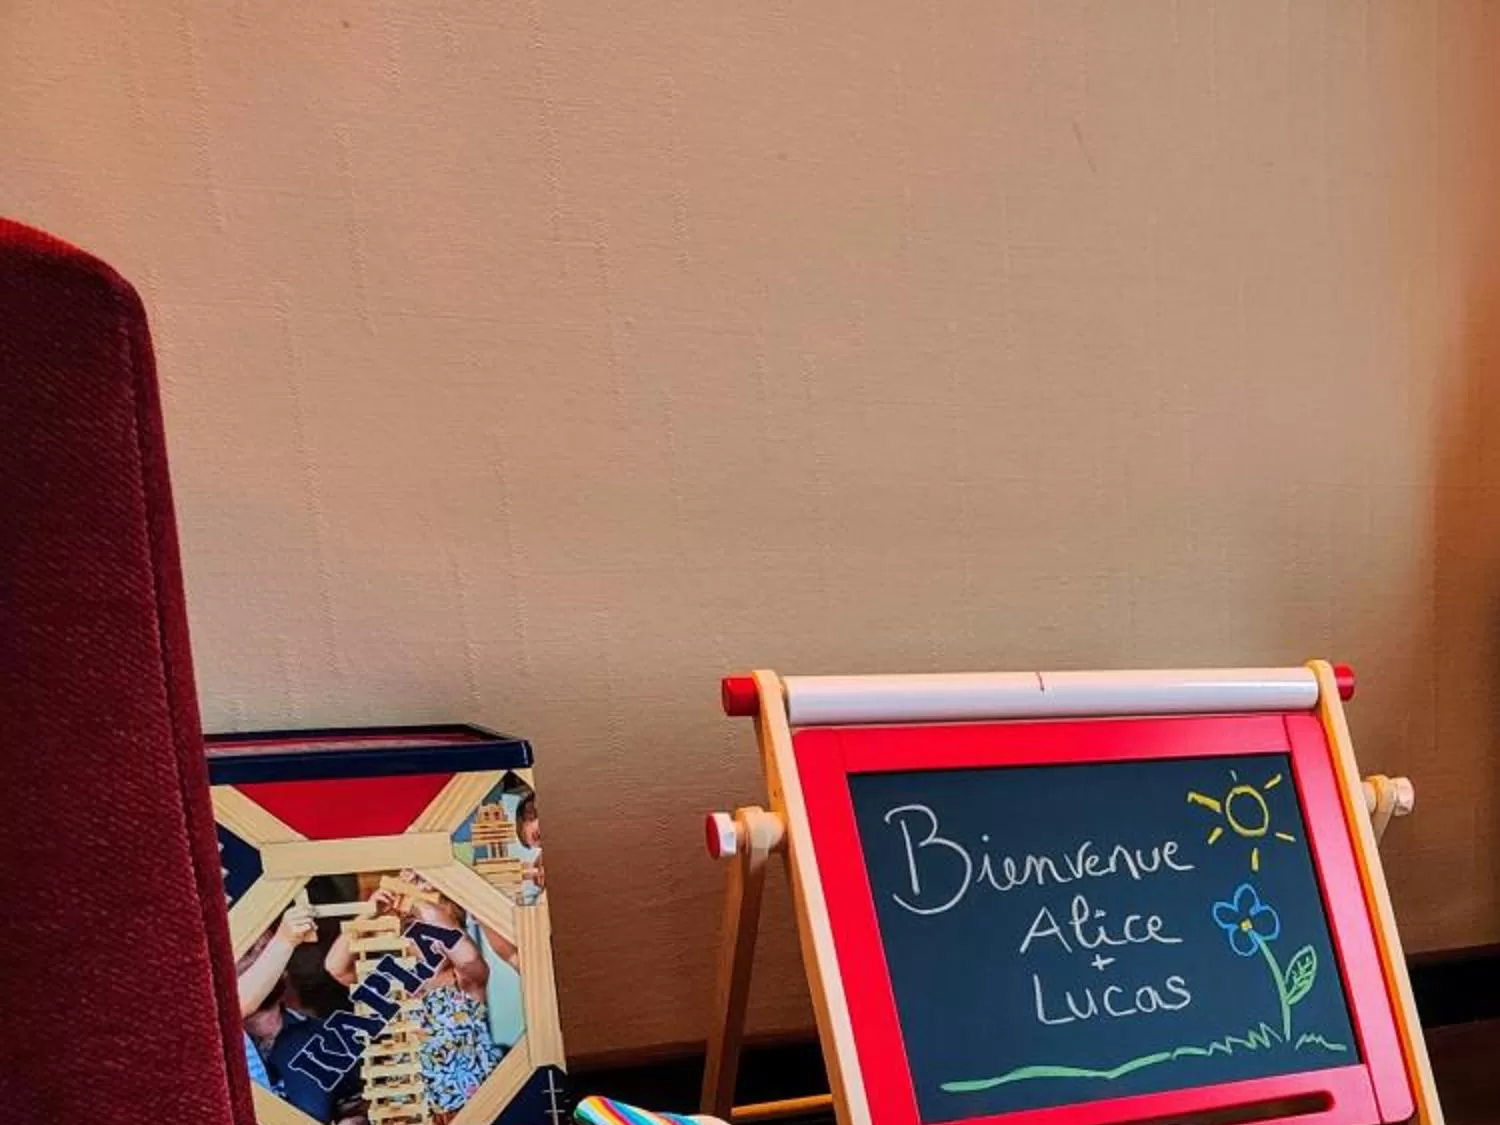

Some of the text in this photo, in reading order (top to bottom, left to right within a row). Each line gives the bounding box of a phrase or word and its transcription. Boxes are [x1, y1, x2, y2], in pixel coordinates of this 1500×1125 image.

[884, 804, 1194, 915] Bienvenue
[1019, 894, 1183, 955] Alice
[1091, 952, 1115, 971] +
[287, 919, 466, 1093] KAPLA
[1031, 972, 1192, 1025] Lucas
